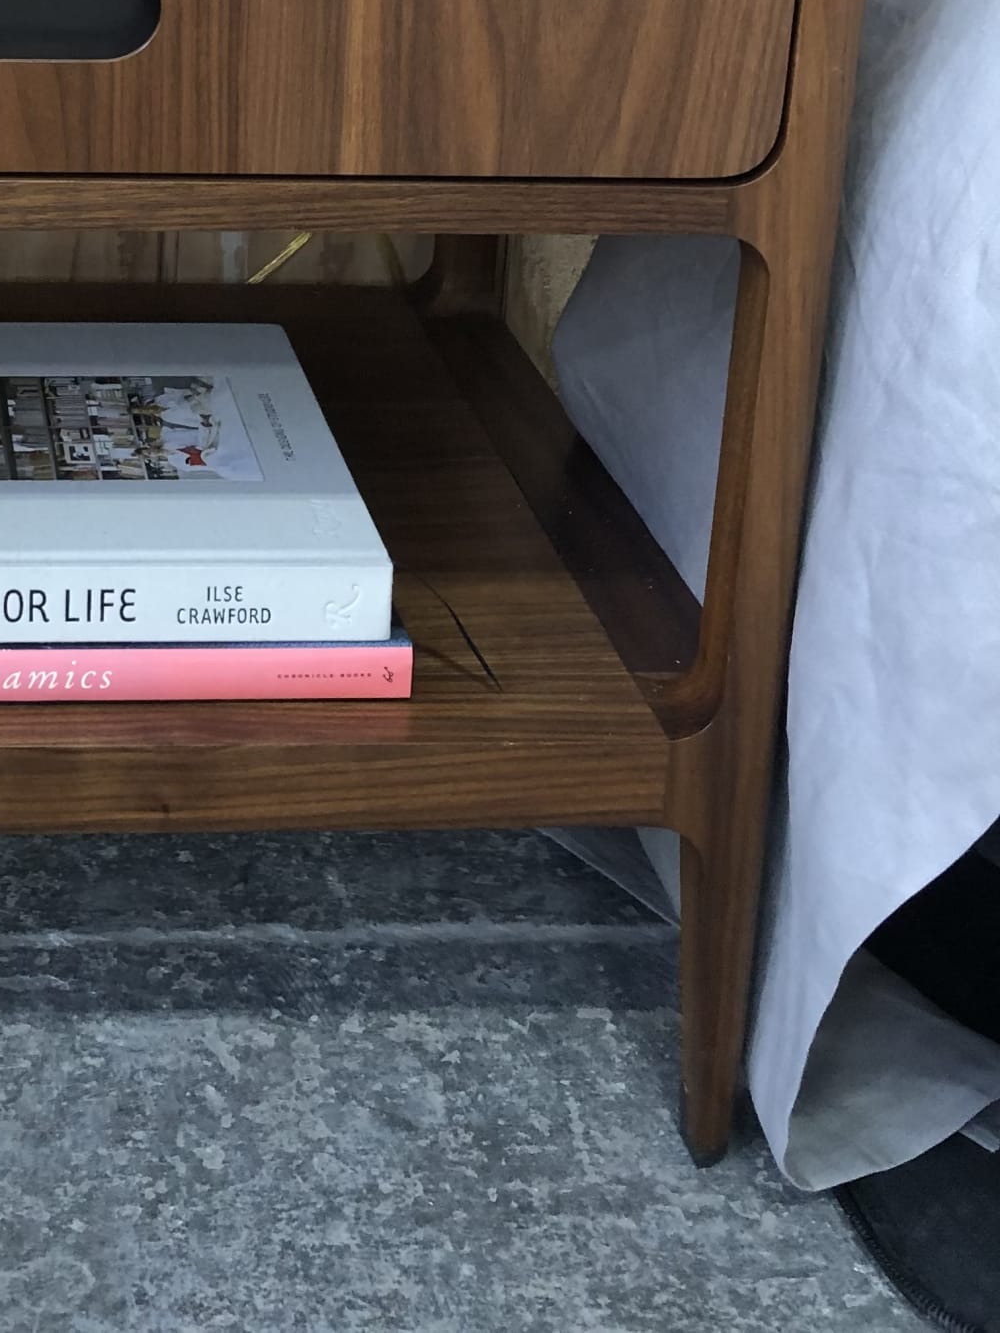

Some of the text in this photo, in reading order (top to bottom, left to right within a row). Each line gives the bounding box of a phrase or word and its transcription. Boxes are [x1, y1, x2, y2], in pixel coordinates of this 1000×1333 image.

[206, 585, 244, 603] ILSE
[63, 587, 137, 623] LIFE
[176, 607, 273, 625] CRAWFORD
